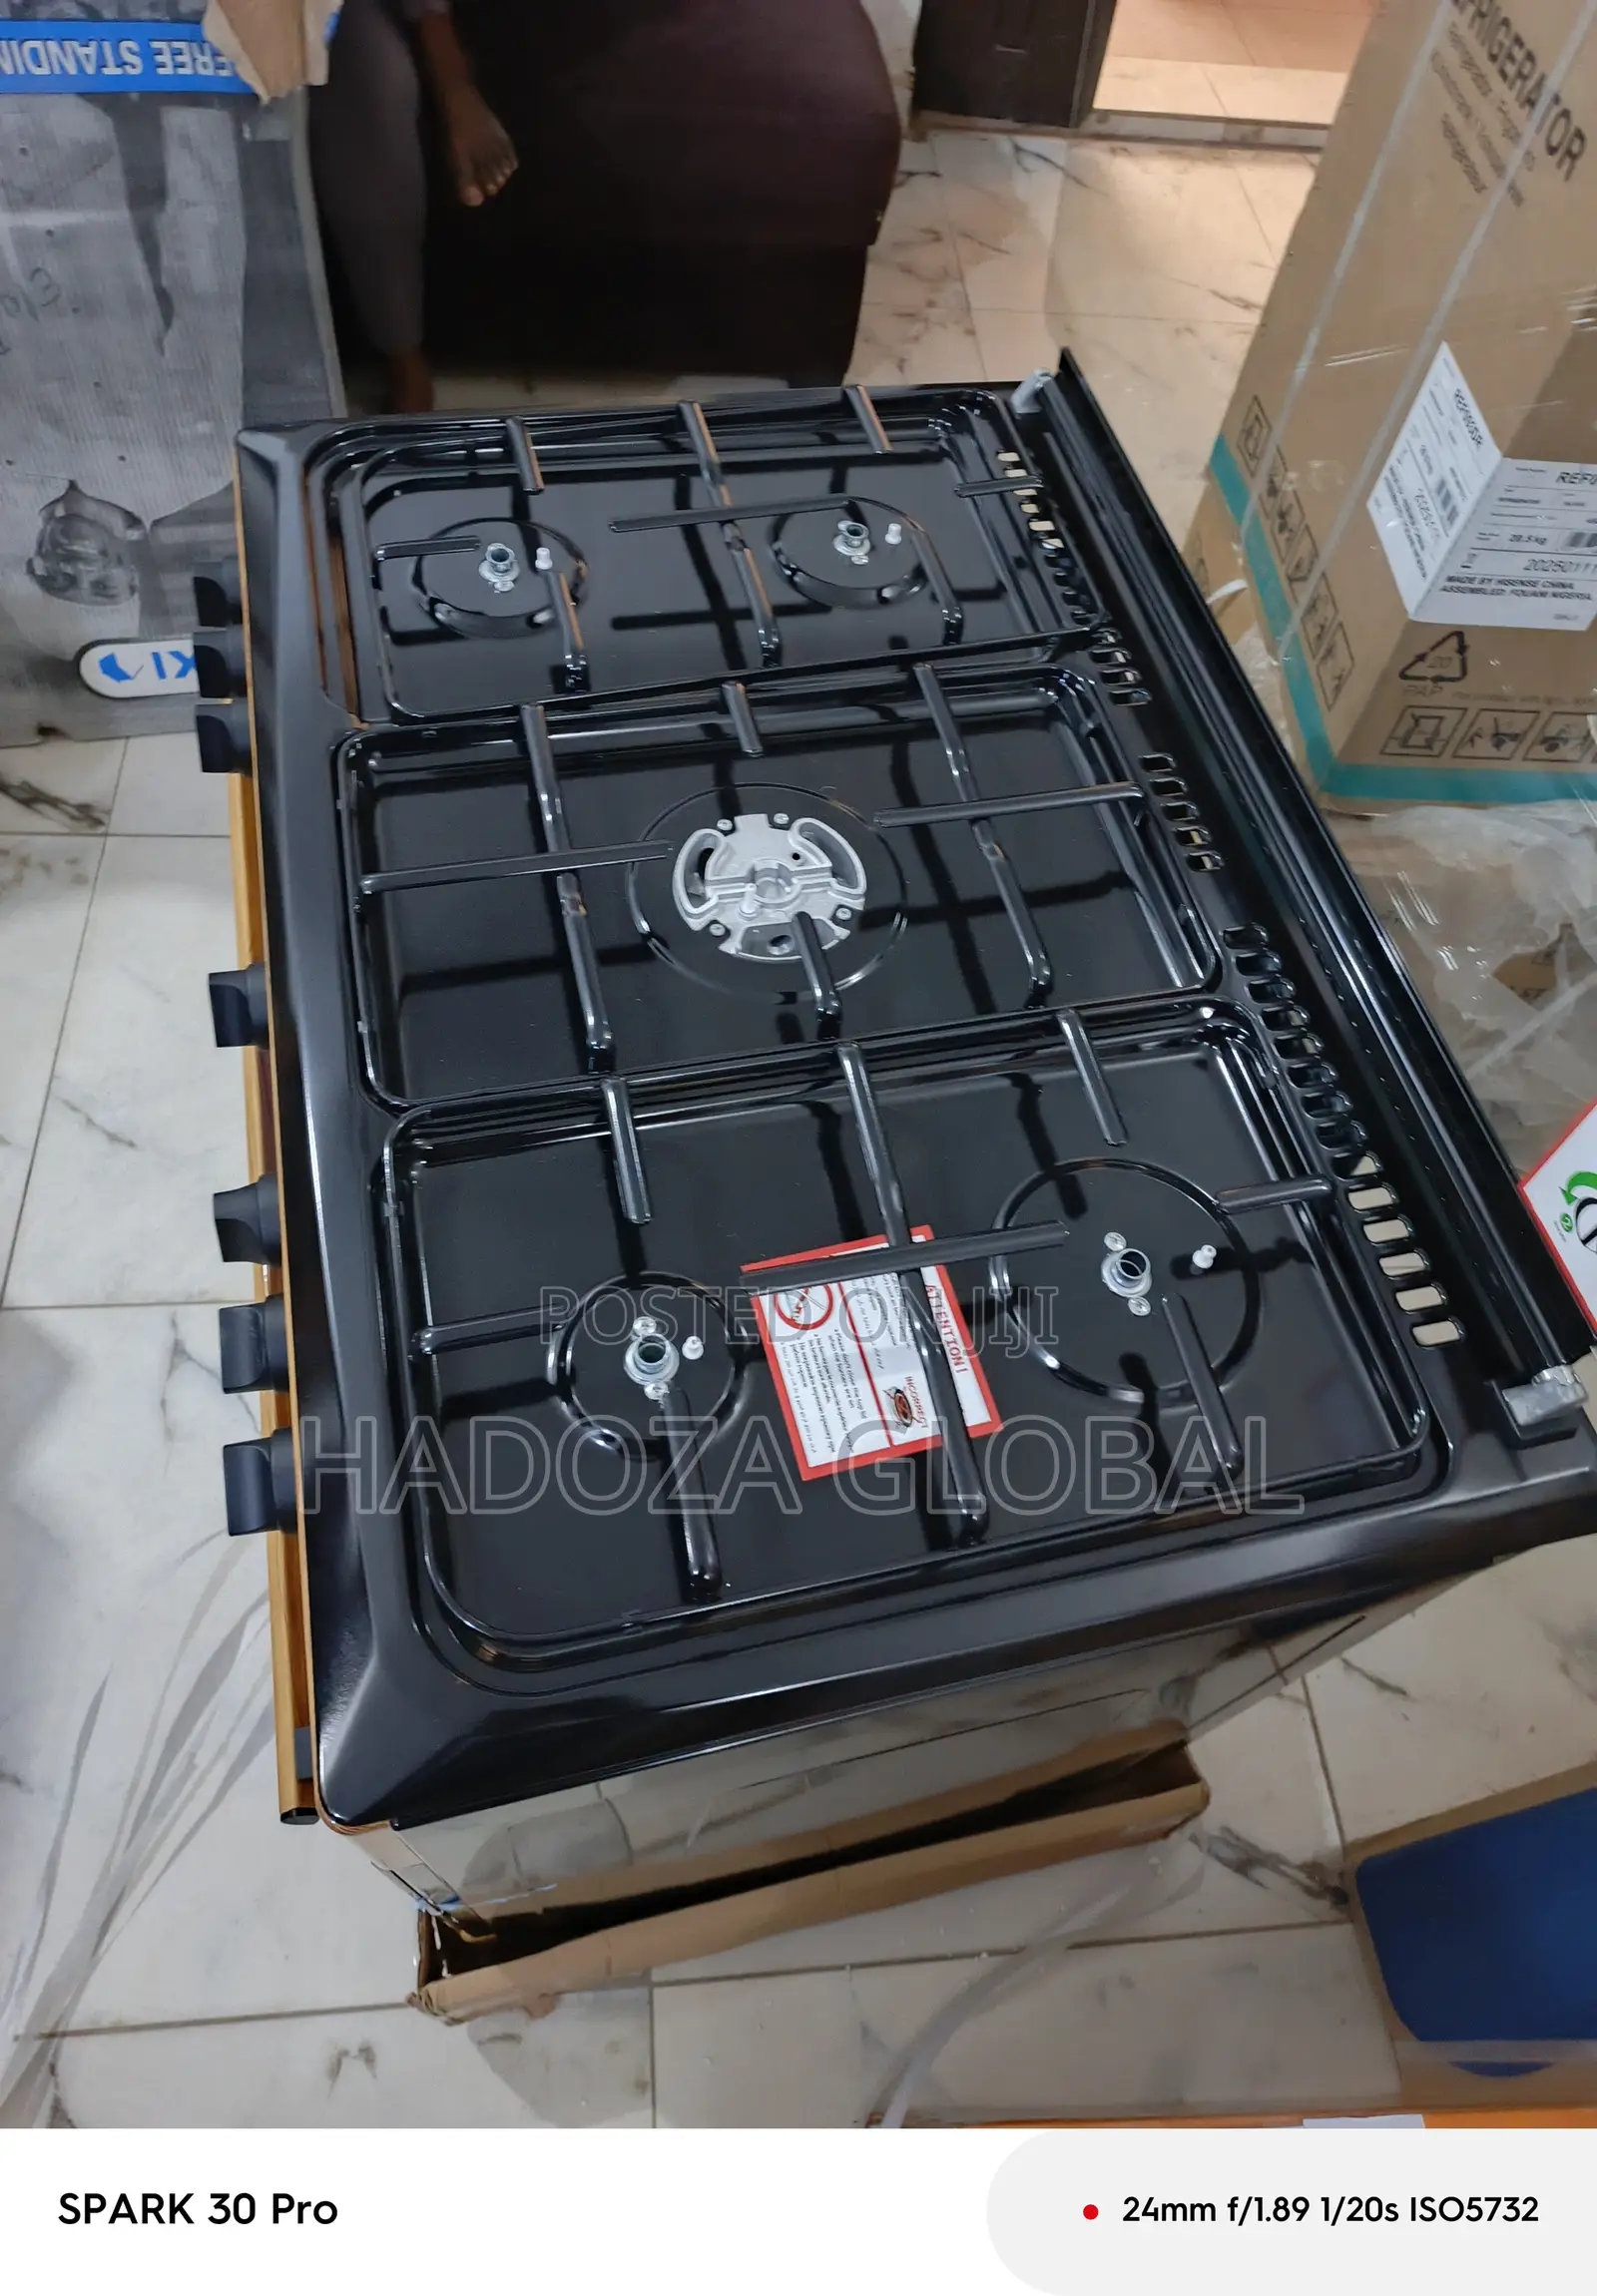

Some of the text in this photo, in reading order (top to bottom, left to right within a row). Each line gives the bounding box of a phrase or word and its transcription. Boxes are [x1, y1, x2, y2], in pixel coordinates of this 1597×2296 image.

[149, 39, 234, 76] FREE
[1451, 0, 1587, 182] RIGERATOR
[1446, 575, 1477, 584] MADE
[925, 1284, 968, 1374] ATTENTION!
[904, 1376, 928, 1428] INCORRECT
